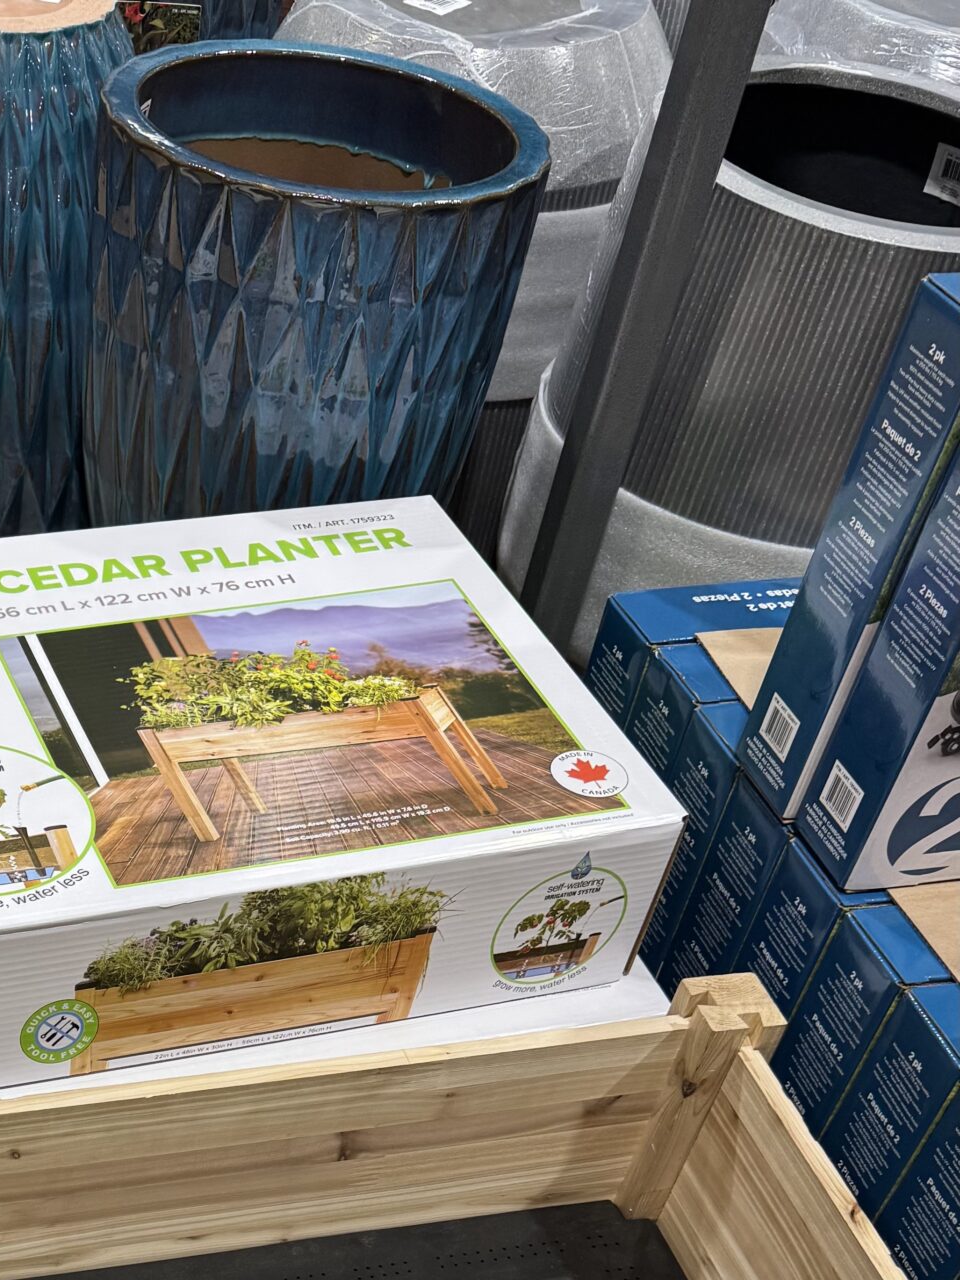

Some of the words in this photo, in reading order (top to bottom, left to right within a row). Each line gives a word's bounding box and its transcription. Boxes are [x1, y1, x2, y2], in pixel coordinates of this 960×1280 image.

[929, 343, 937, 355] 2
[933, 350, 946, 364] pk
[881, 419, 906, 448] Paquet
[905, 443, 915, 456] de
[914, 450, 921, 461] 2
[325, 519, 349, 527] ART.
[849, 516, 856, 527] 2
[854, 521, 875, 548] Piezas
[180, 528, 413, 574] PLANTER
[25, 604, 57, 616] cm
[60, 599, 76, 613] L
[79, 599, 92, 609] x
[94, 592, 131, 607] 122
[136, 587, 168, 603] cm
[169, 584, 192, 598] W
[198, 584, 211, 596] x
[212, 580, 240, 594] 76
[244, 576, 275, 590] cm
[277, 573, 297, 586] H
[692, 593, 741, 603] Piezas
[741, 592, 753, 600] 2
[919, 584, 927, 595] 2
[925, 590, 948, 618] Piezas
[746, 604, 758, 612] 2
[559, 752, 581, 762] MADE
[581, 785, 620, 796] CANADA
[11, 886, 59, 906] water
[59, 868, 90, 890] less
[544, 889, 577, 901] IRRIGATION
[577, 887, 601, 898] SYSTEM
[547, 877, 605, 893] self-watering
[492, 979, 513, 992] grow
[540, 976, 567, 991] water
[567, 966, 588, 979] less
[26, 1005, 57, 1033] QUICK
[73, 1004, 95, 1023] EASY
[27, 1044, 56, 1060] TOOL
[61, 1034, 91, 1059] FREE
[867, 1092, 888, 1126] Paquet
[886, 1123, 895, 1137] de
[893, 1135, 900, 1144] 2
[927, 1177, 950, 1212] Paquet
[948, 1211, 958, 1225] de
[894, 1244, 900, 1254] 2
